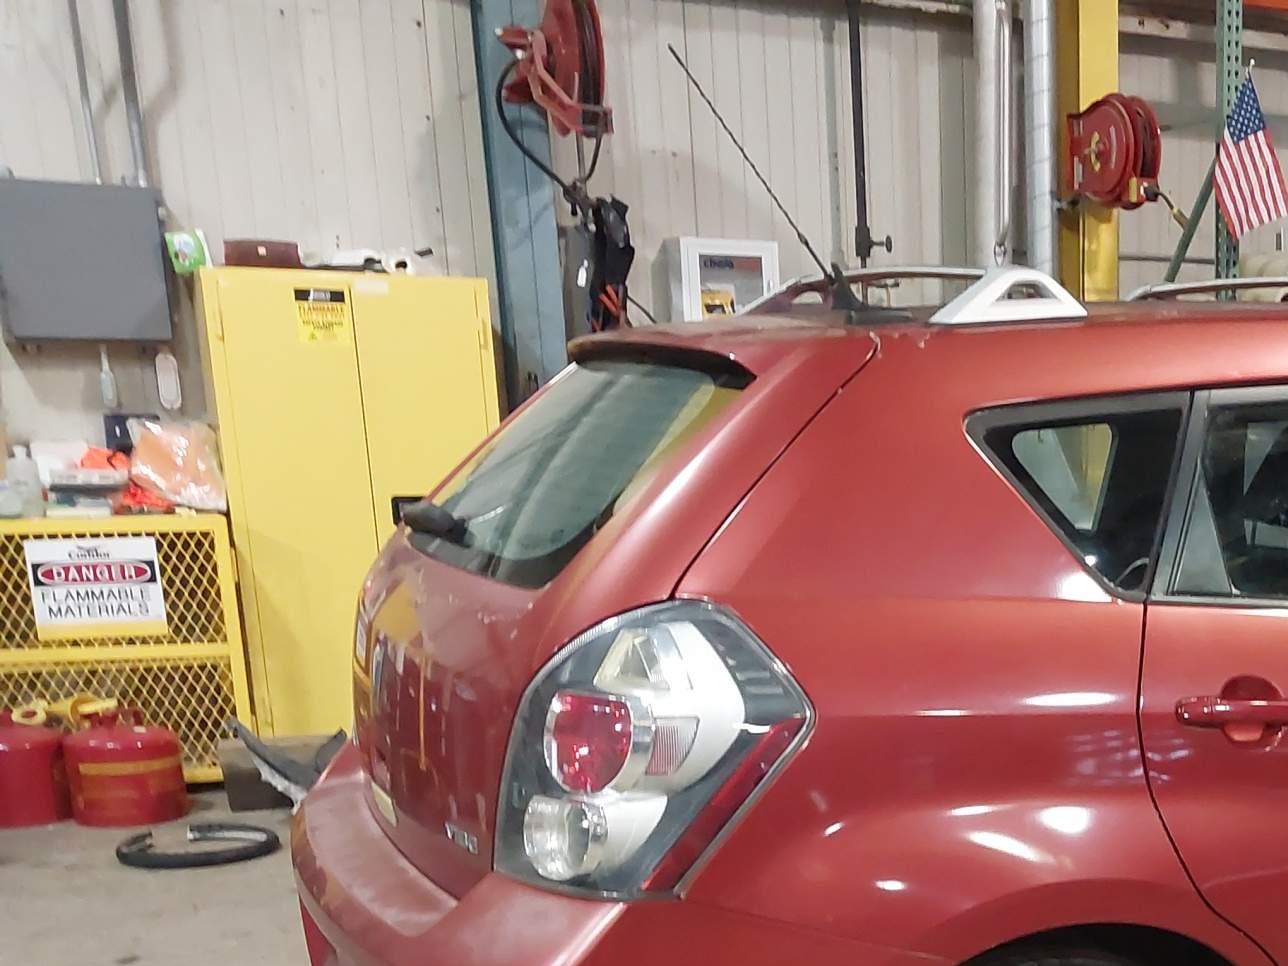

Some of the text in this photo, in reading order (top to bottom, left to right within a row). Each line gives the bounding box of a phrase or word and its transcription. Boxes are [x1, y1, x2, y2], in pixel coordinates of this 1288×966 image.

[51, 563, 137, 583] DANGER
[41, 586, 150, 603] FLAMMABLE
[47, 601, 150, 619] MATERIALS
